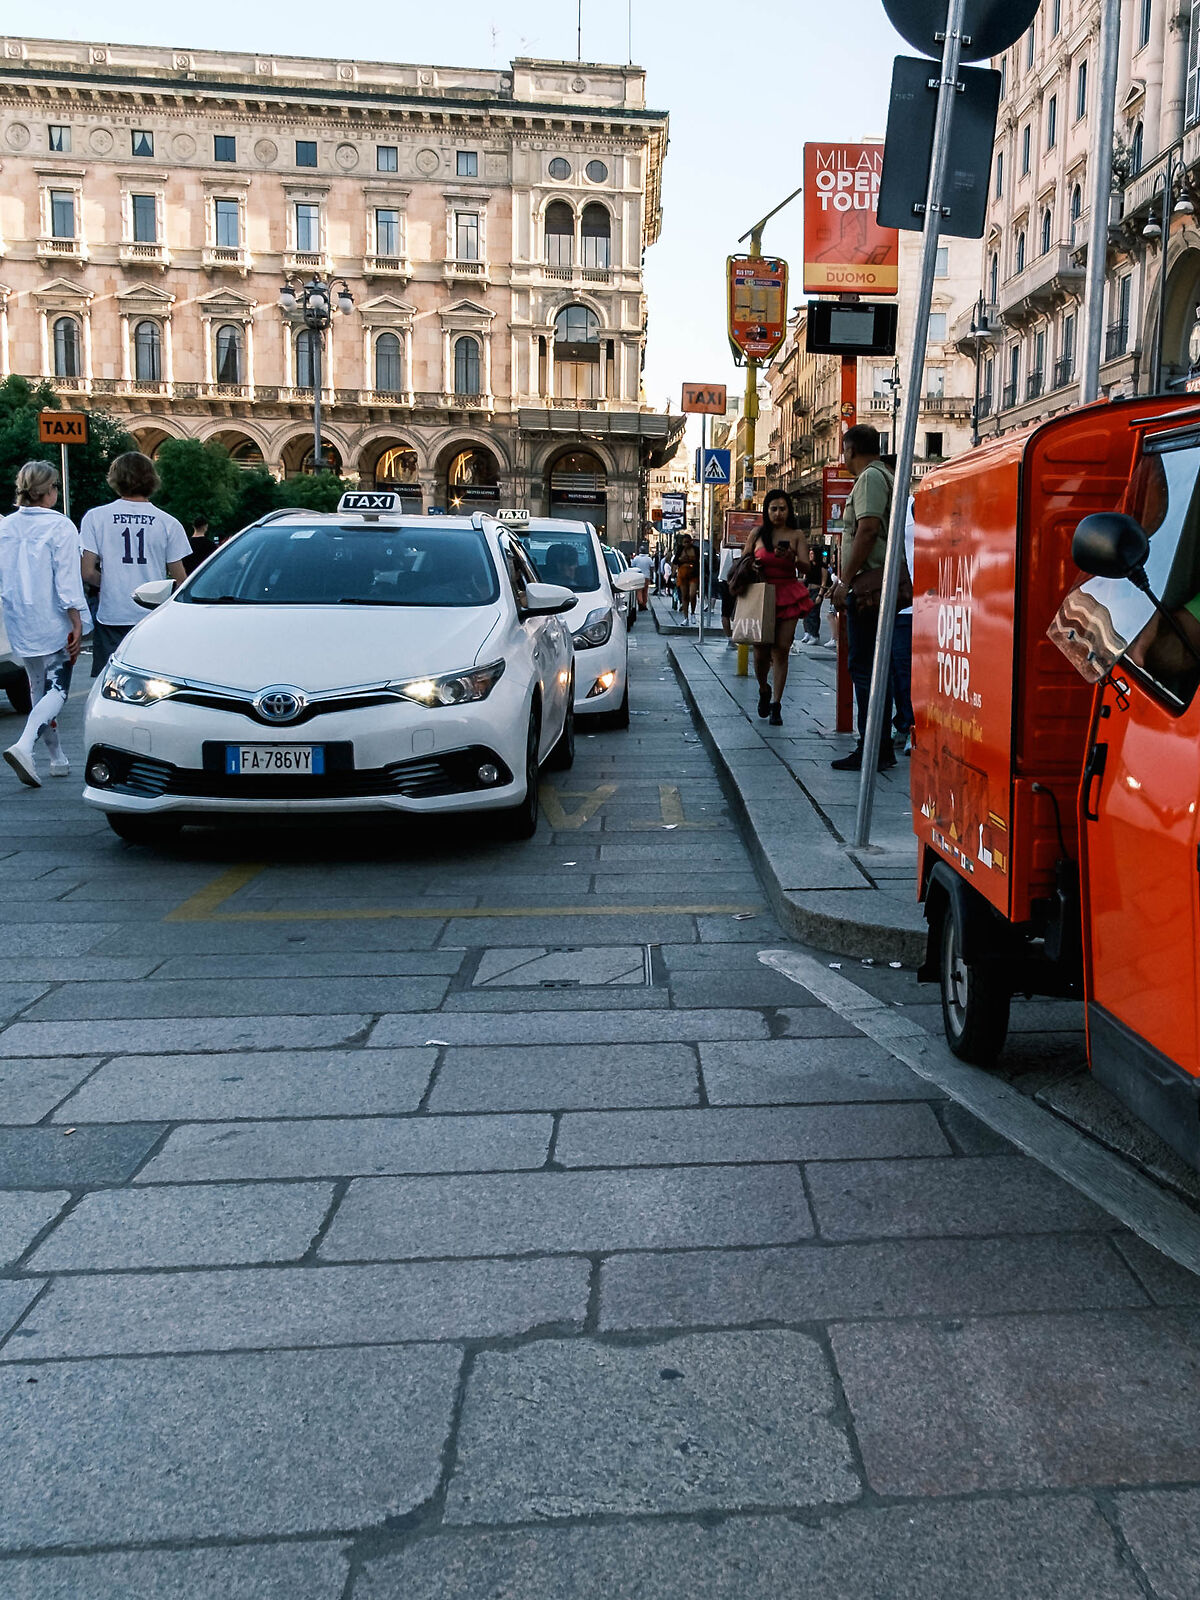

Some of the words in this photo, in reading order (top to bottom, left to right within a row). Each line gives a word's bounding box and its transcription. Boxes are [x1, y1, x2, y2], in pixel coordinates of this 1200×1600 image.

[826, 271, 876, 284] DUOMO
[685, 390, 722, 406] TAXI
[42, 420, 82, 436] TAXI
[346, 494, 392, 508] TAXI
[112, 513, 156, 526] PETTEY
[500, 510, 528, 520] TAXI
[121, 526, 148, 565] 11
[937, 554, 973, 601] MILAN
[937, 604, 972, 654] OPEN
[937, 651, 970, 703] TOUR
